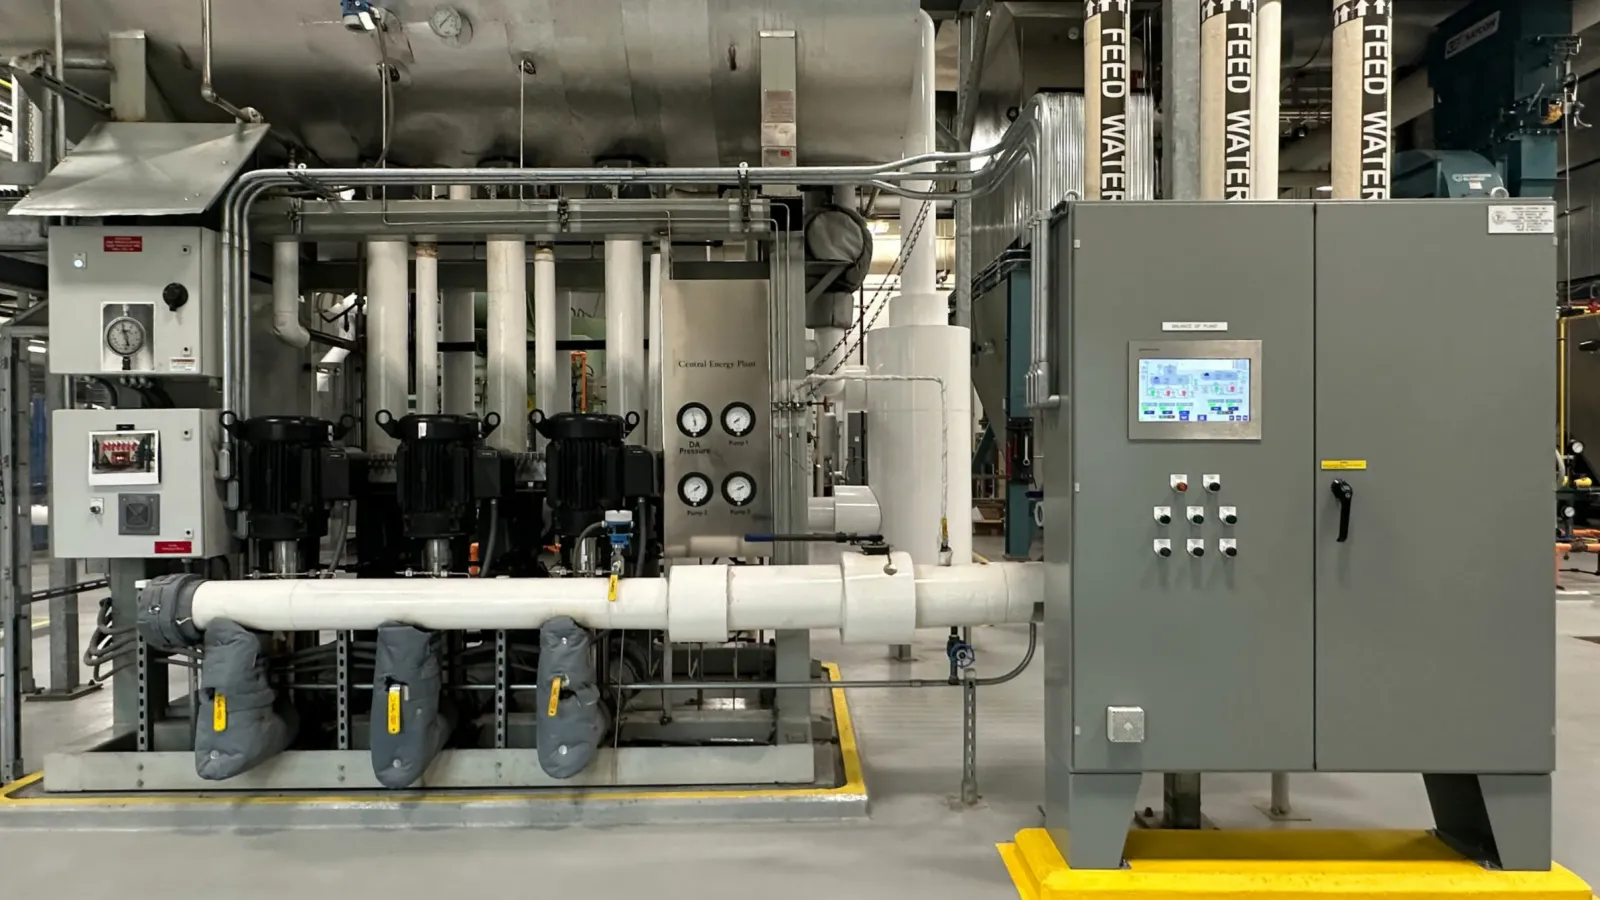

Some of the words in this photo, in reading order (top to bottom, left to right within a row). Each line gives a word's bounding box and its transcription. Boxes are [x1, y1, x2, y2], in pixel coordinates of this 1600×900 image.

[1102, 28, 1125, 98] FEED
[1227, 23, 1251, 93] FEED
[1364, 25, 1388, 94] FEED
[1226, 109, 1250, 200] WATER
[1362, 110, 1387, 200] WATER
[678, 360, 707, 368] Central
[709, 360, 734, 369] Energy
